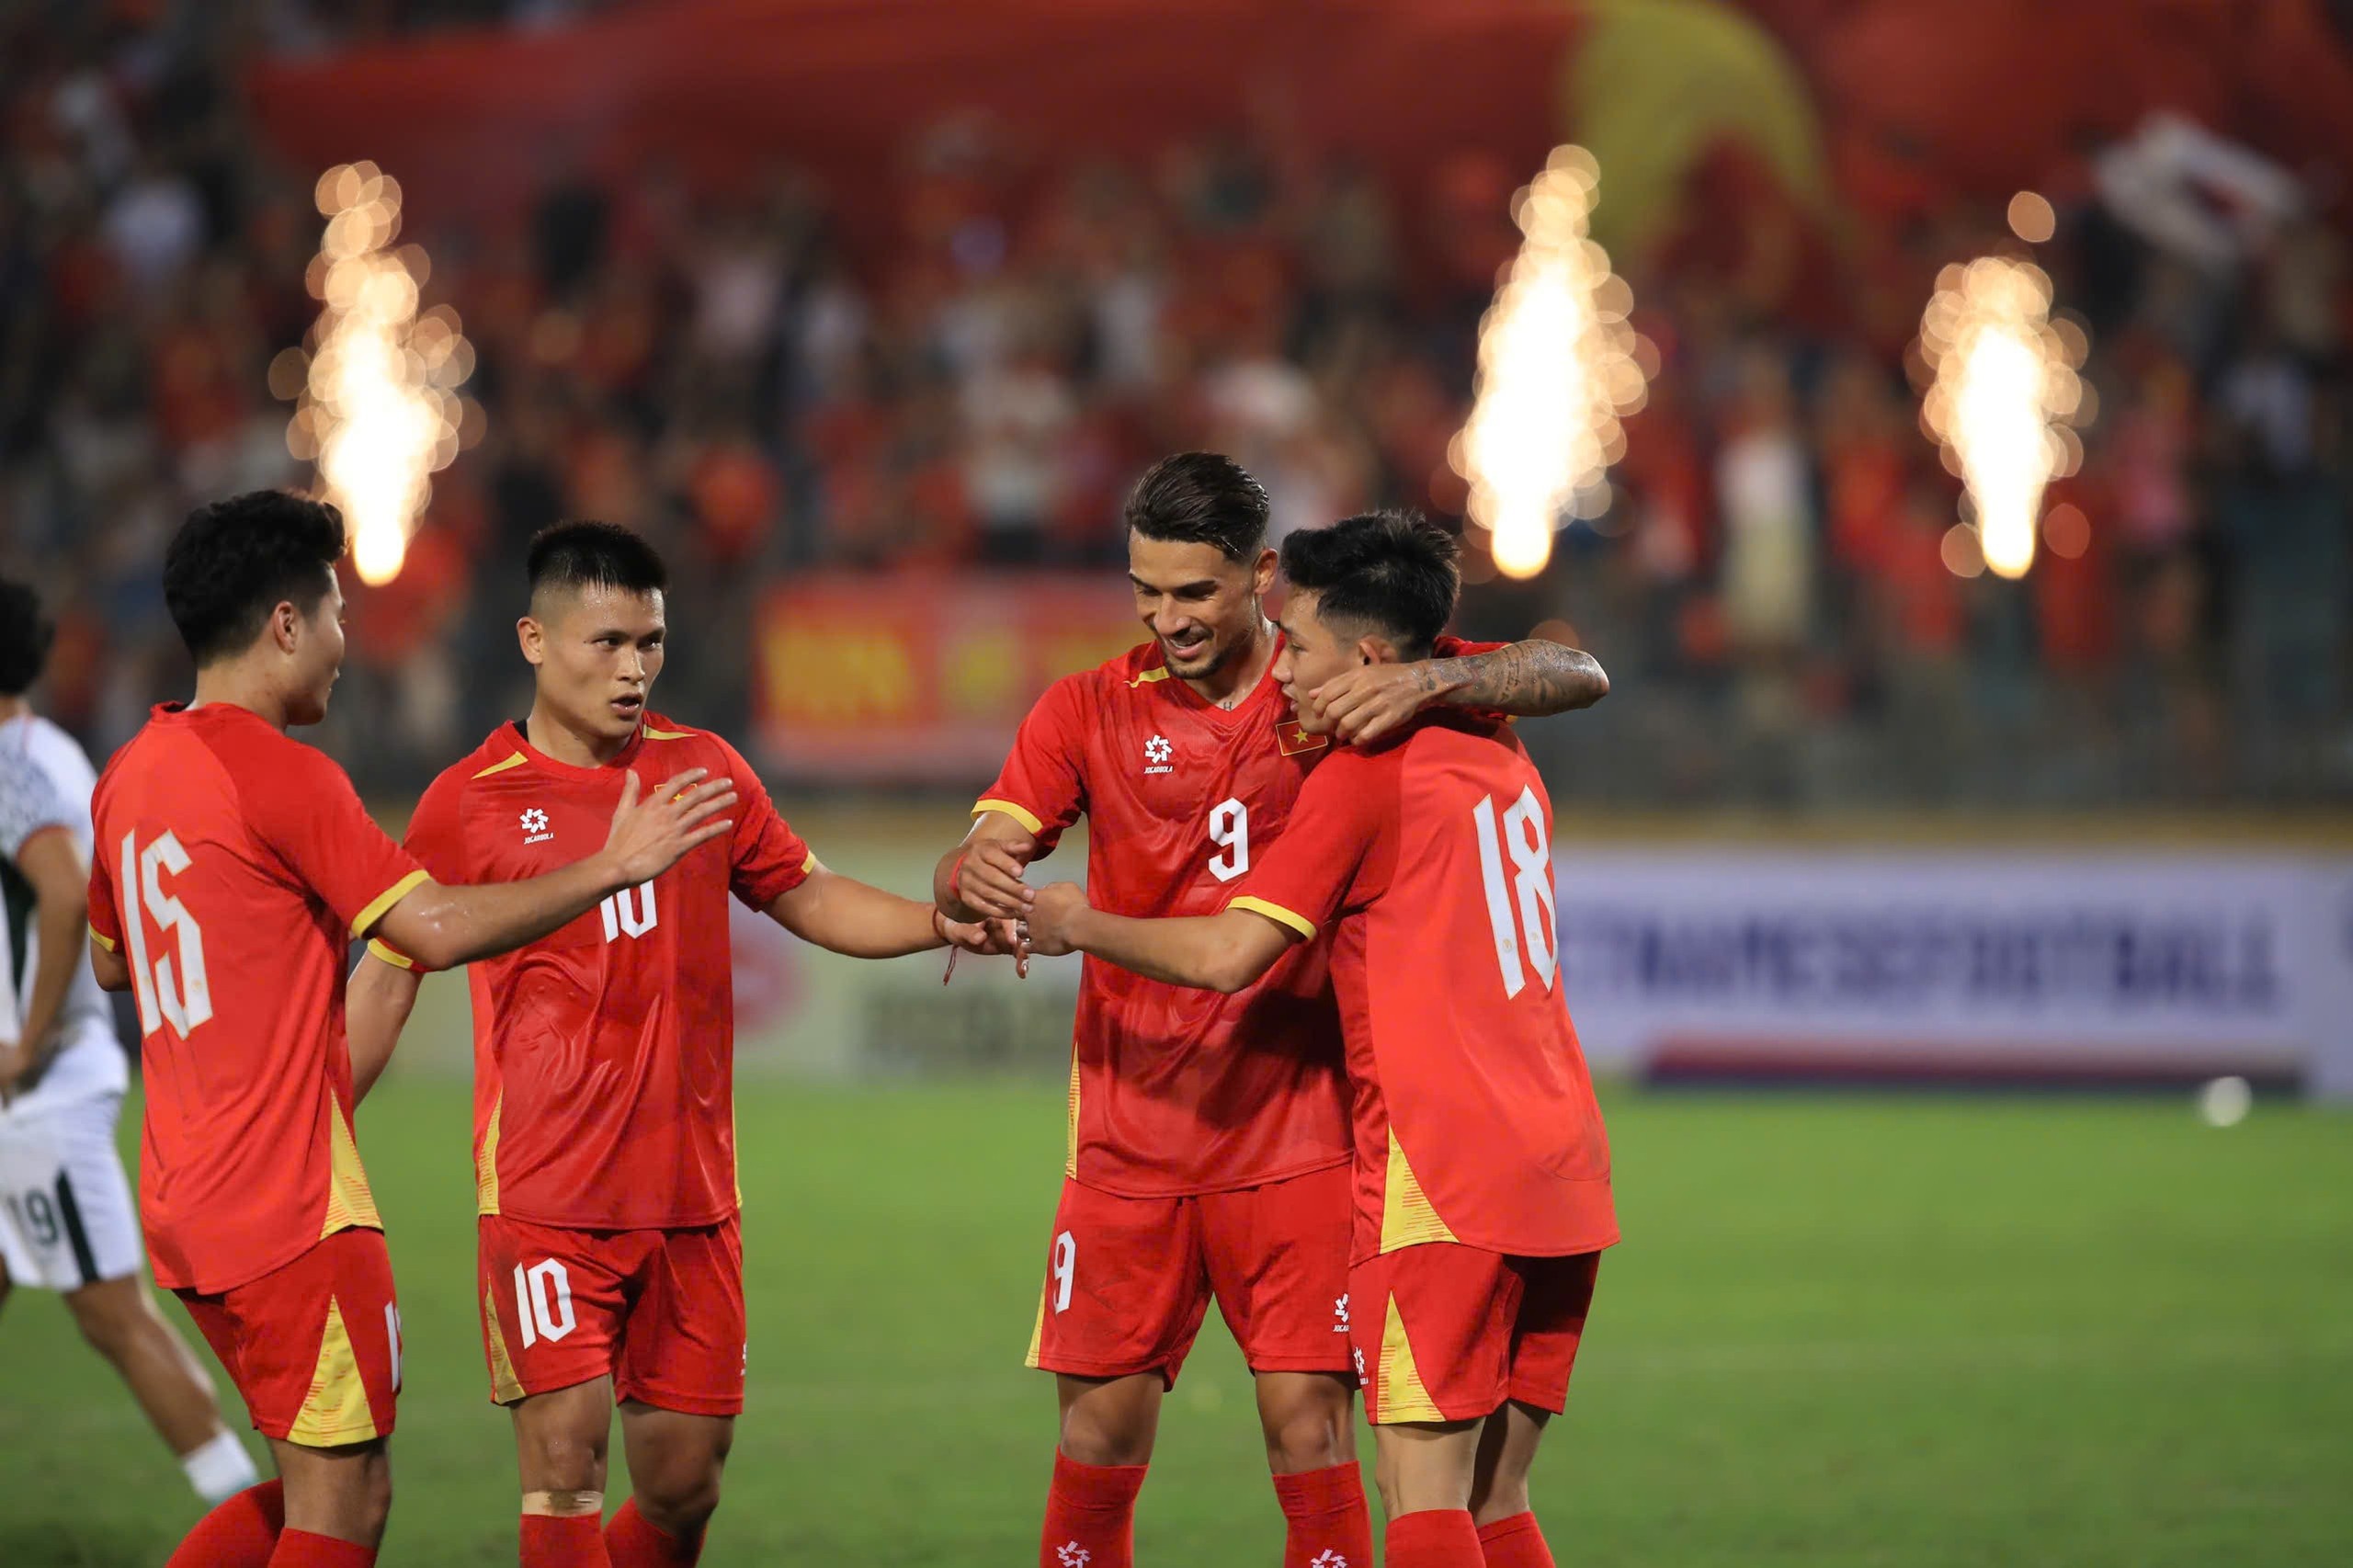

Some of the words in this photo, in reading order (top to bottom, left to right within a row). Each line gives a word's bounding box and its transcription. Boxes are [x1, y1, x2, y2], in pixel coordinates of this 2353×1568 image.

[1208, 797, 1249, 882] 9
[120, 828, 213, 1041] 15
[1472, 783, 1559, 1000] 18
[6, 1187, 60, 1248] 19
[513, 1257, 576, 1349] 10
[1053, 1230, 1076, 1314] 9
[384, 1301, 403, 1392] 1
